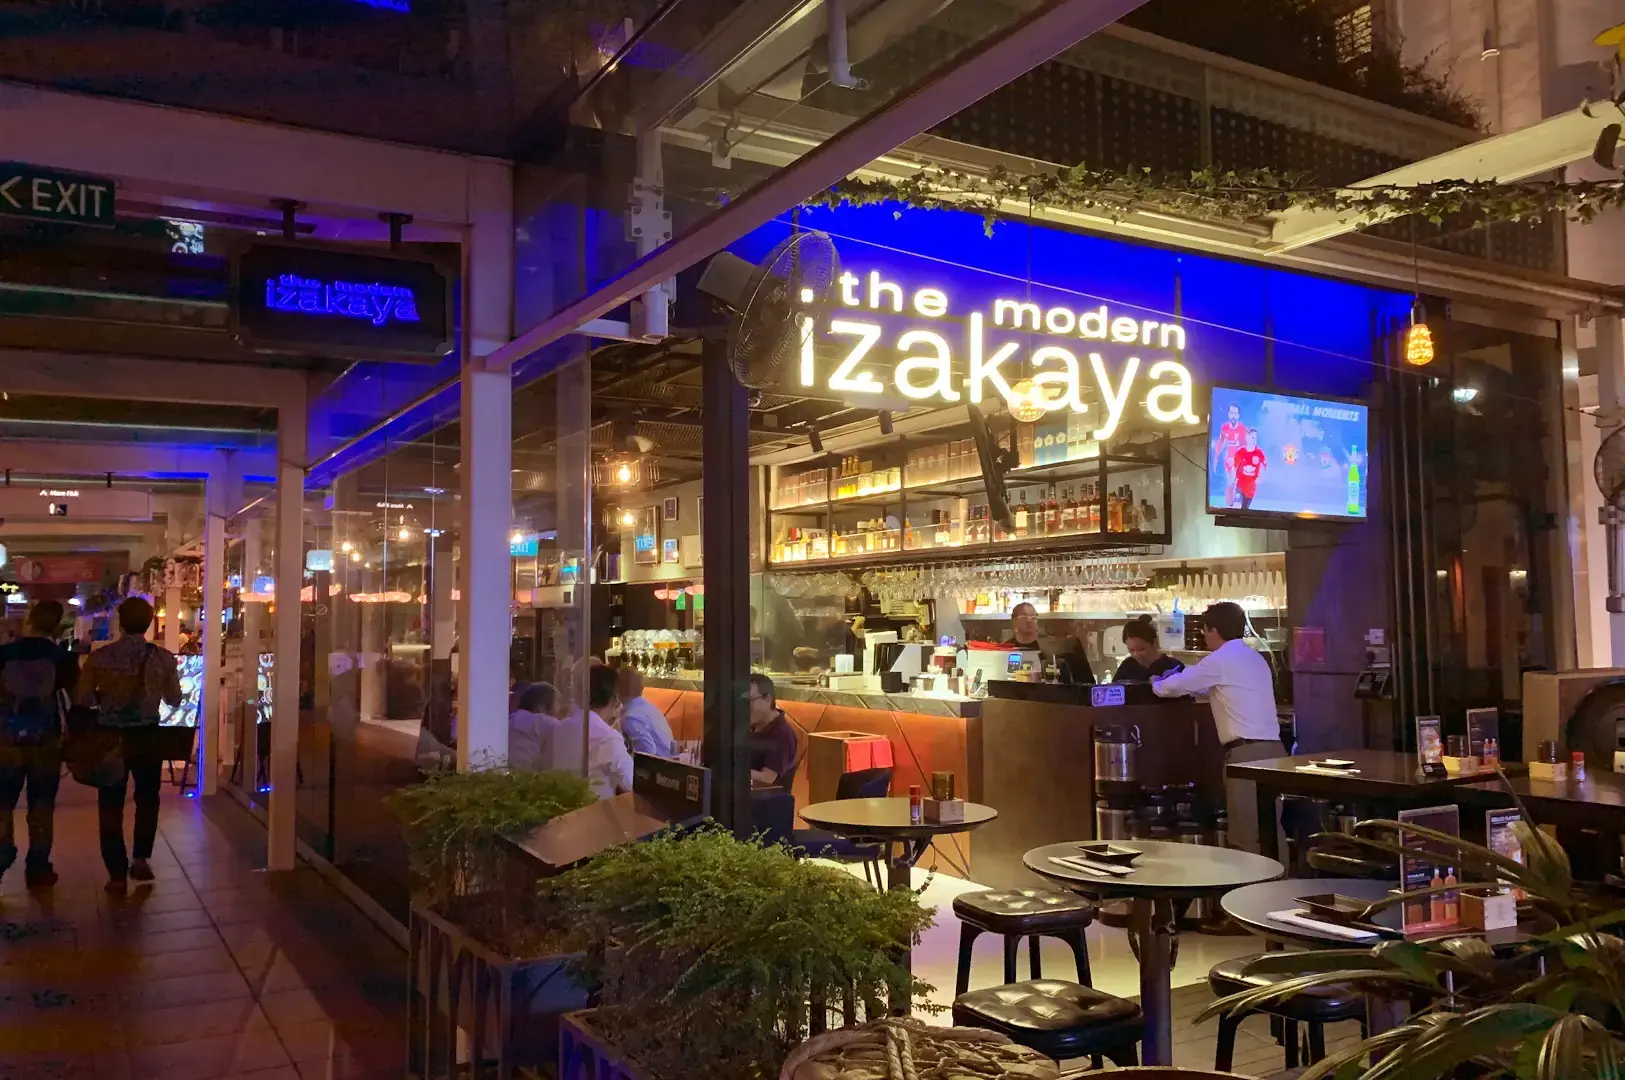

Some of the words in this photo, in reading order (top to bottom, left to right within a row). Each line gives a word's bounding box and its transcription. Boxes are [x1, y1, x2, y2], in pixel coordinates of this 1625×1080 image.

[32, 177, 107, 218] EXIT
[266, 279, 420, 326] izakaya
[279, 274, 321, 288] the
[334, 281, 413, 297] modern
[839, 270, 948, 317] the
[994, 297, 1187, 350] modern
[799, 288, 1200, 440] izakaya
